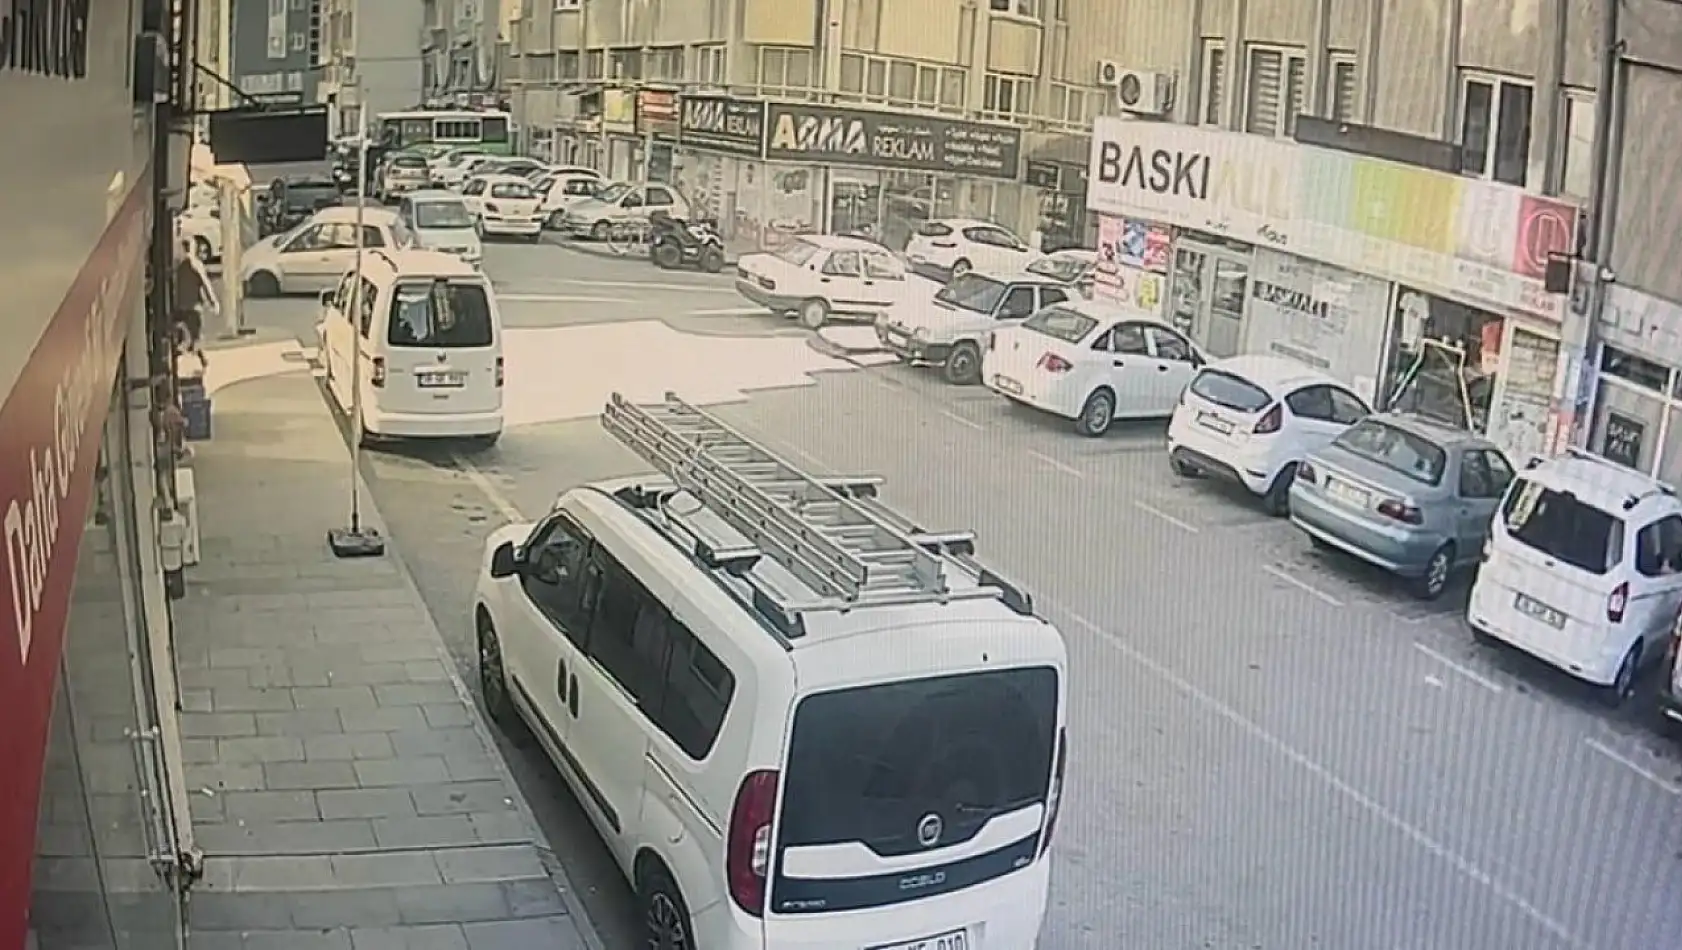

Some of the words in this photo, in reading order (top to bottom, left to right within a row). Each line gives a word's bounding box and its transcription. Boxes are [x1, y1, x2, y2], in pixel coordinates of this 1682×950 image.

[871, 134, 935, 161] REKLAM
[1099, 140, 1211, 200] BASKI
[4, 446, 59, 666] Daha
